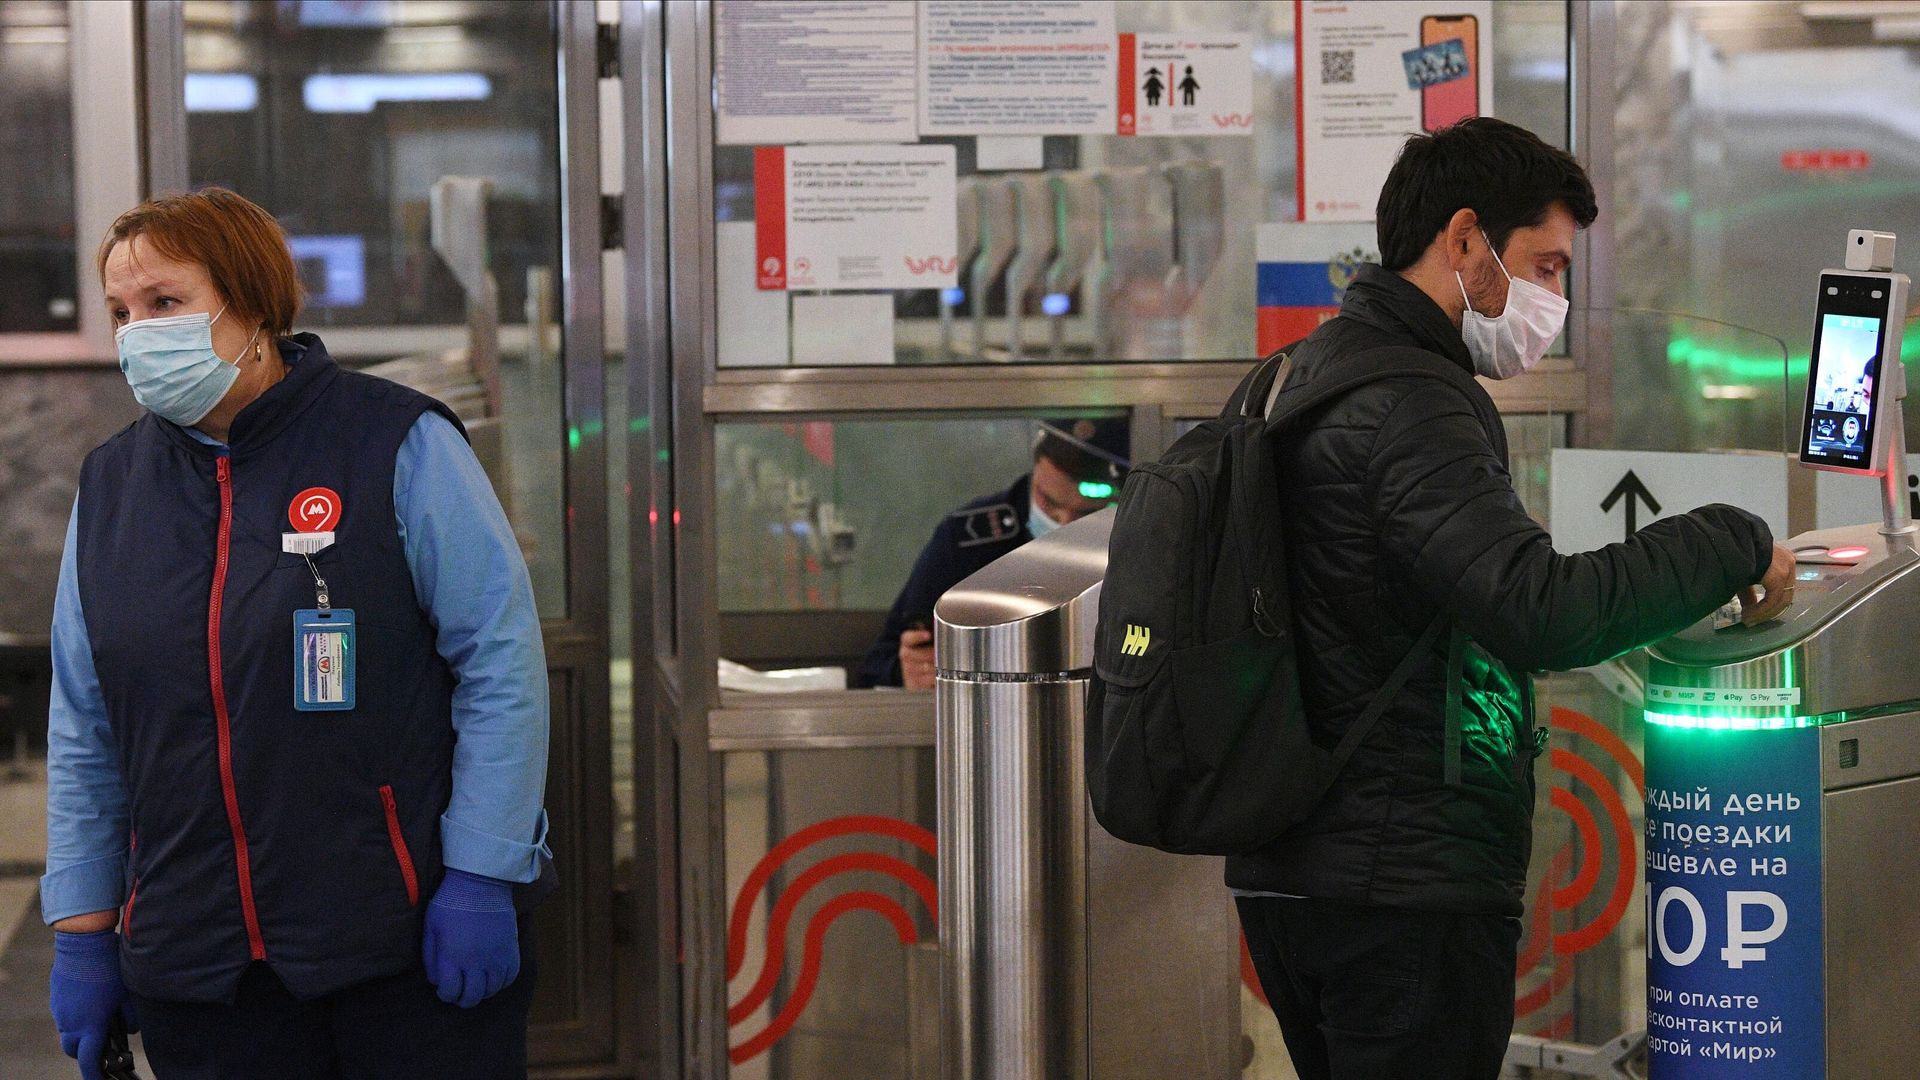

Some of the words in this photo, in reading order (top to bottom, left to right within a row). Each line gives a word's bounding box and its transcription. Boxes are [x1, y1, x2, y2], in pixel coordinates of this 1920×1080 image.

[1121, 624, 1150, 656] HH
[1729, 693, 1743, 702] Pay
[1758, 693, 1770, 702] Pay
[1723, 792, 1801, 816] день
[1663, 821, 1791, 848] поездки
[1646, 849, 1738, 877] ешевле
[1751, 856, 1787, 877] на
[1649, 985, 1673, 1004] при
[1679, 991, 1759, 1009] оплате
[1647, 1009, 1783, 1035] есконтактной
[1699, 1041, 1777, 1063] «Мир»
